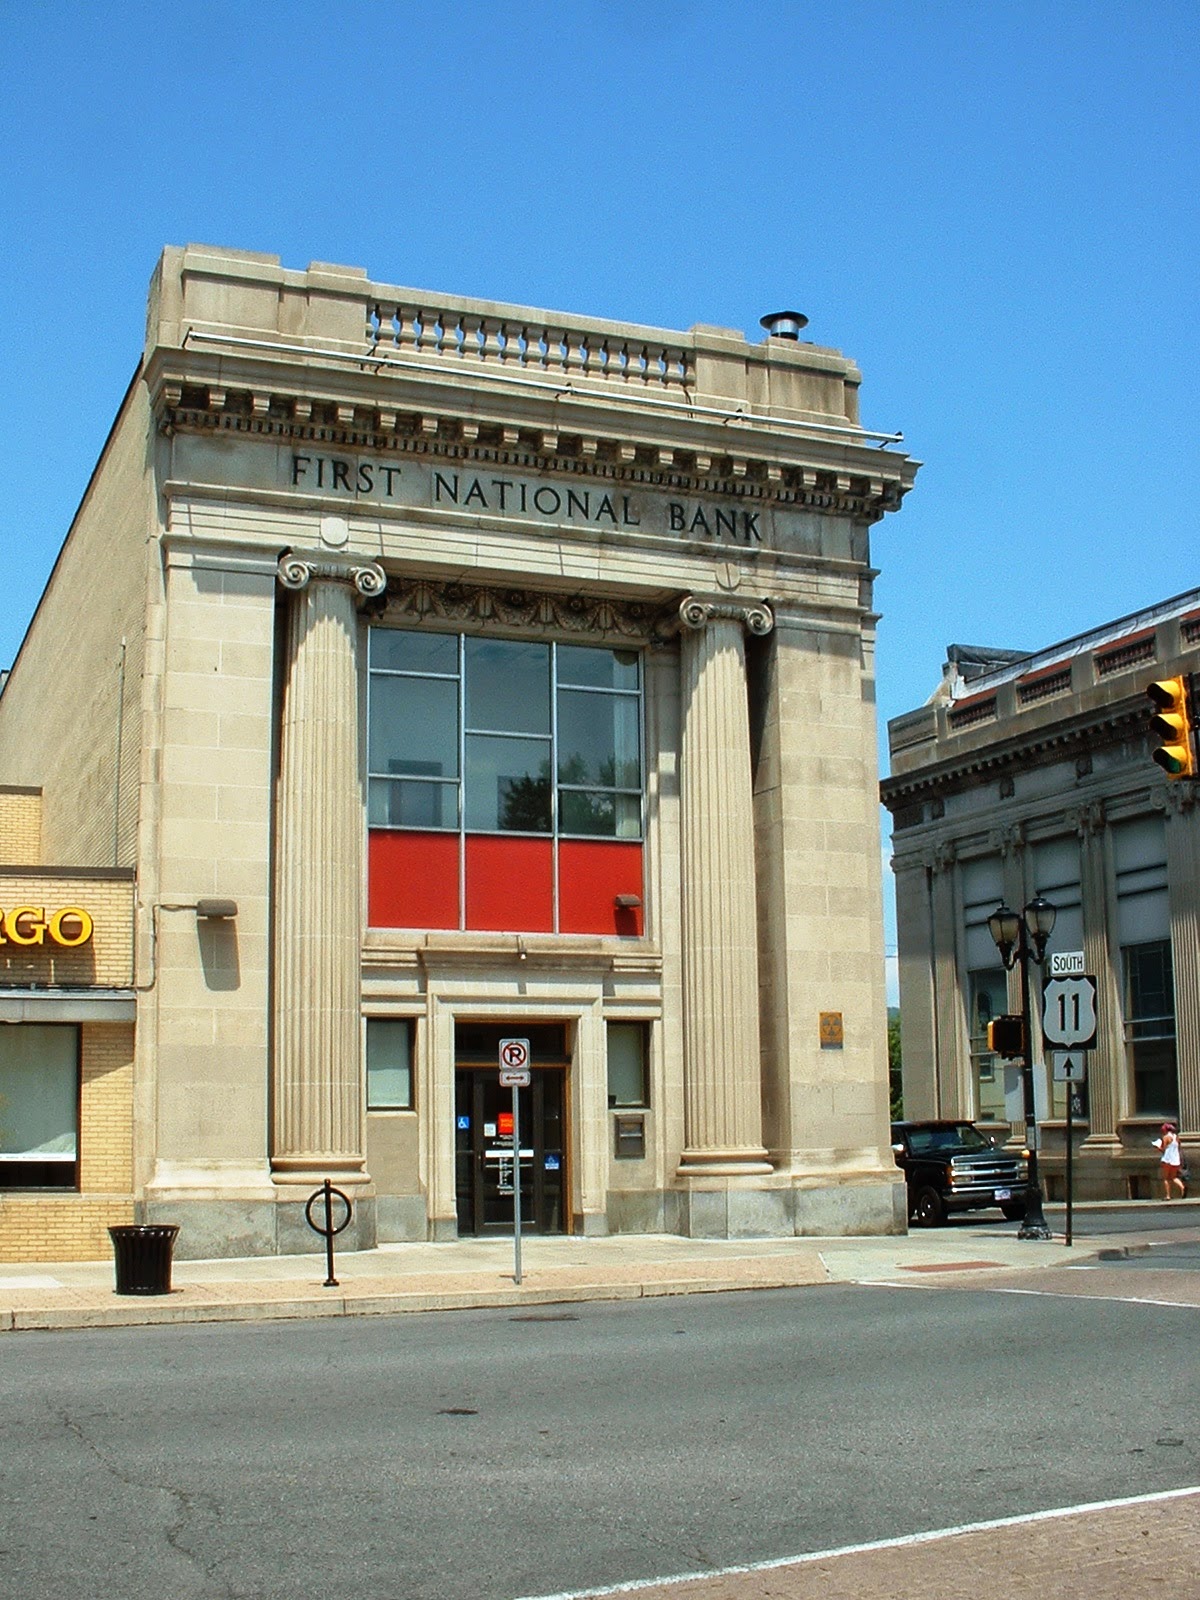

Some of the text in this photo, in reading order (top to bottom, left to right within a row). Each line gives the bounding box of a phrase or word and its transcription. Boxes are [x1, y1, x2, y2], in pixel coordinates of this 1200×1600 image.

[292, 455, 762, 541] FIRST NATIONAL BANK
[0, 906, 94, 947] GO
[1053, 955, 1083, 971] SOUTH
[1058, 993, 1080, 1031] 11
[509, 1047, 522, 1063] P
